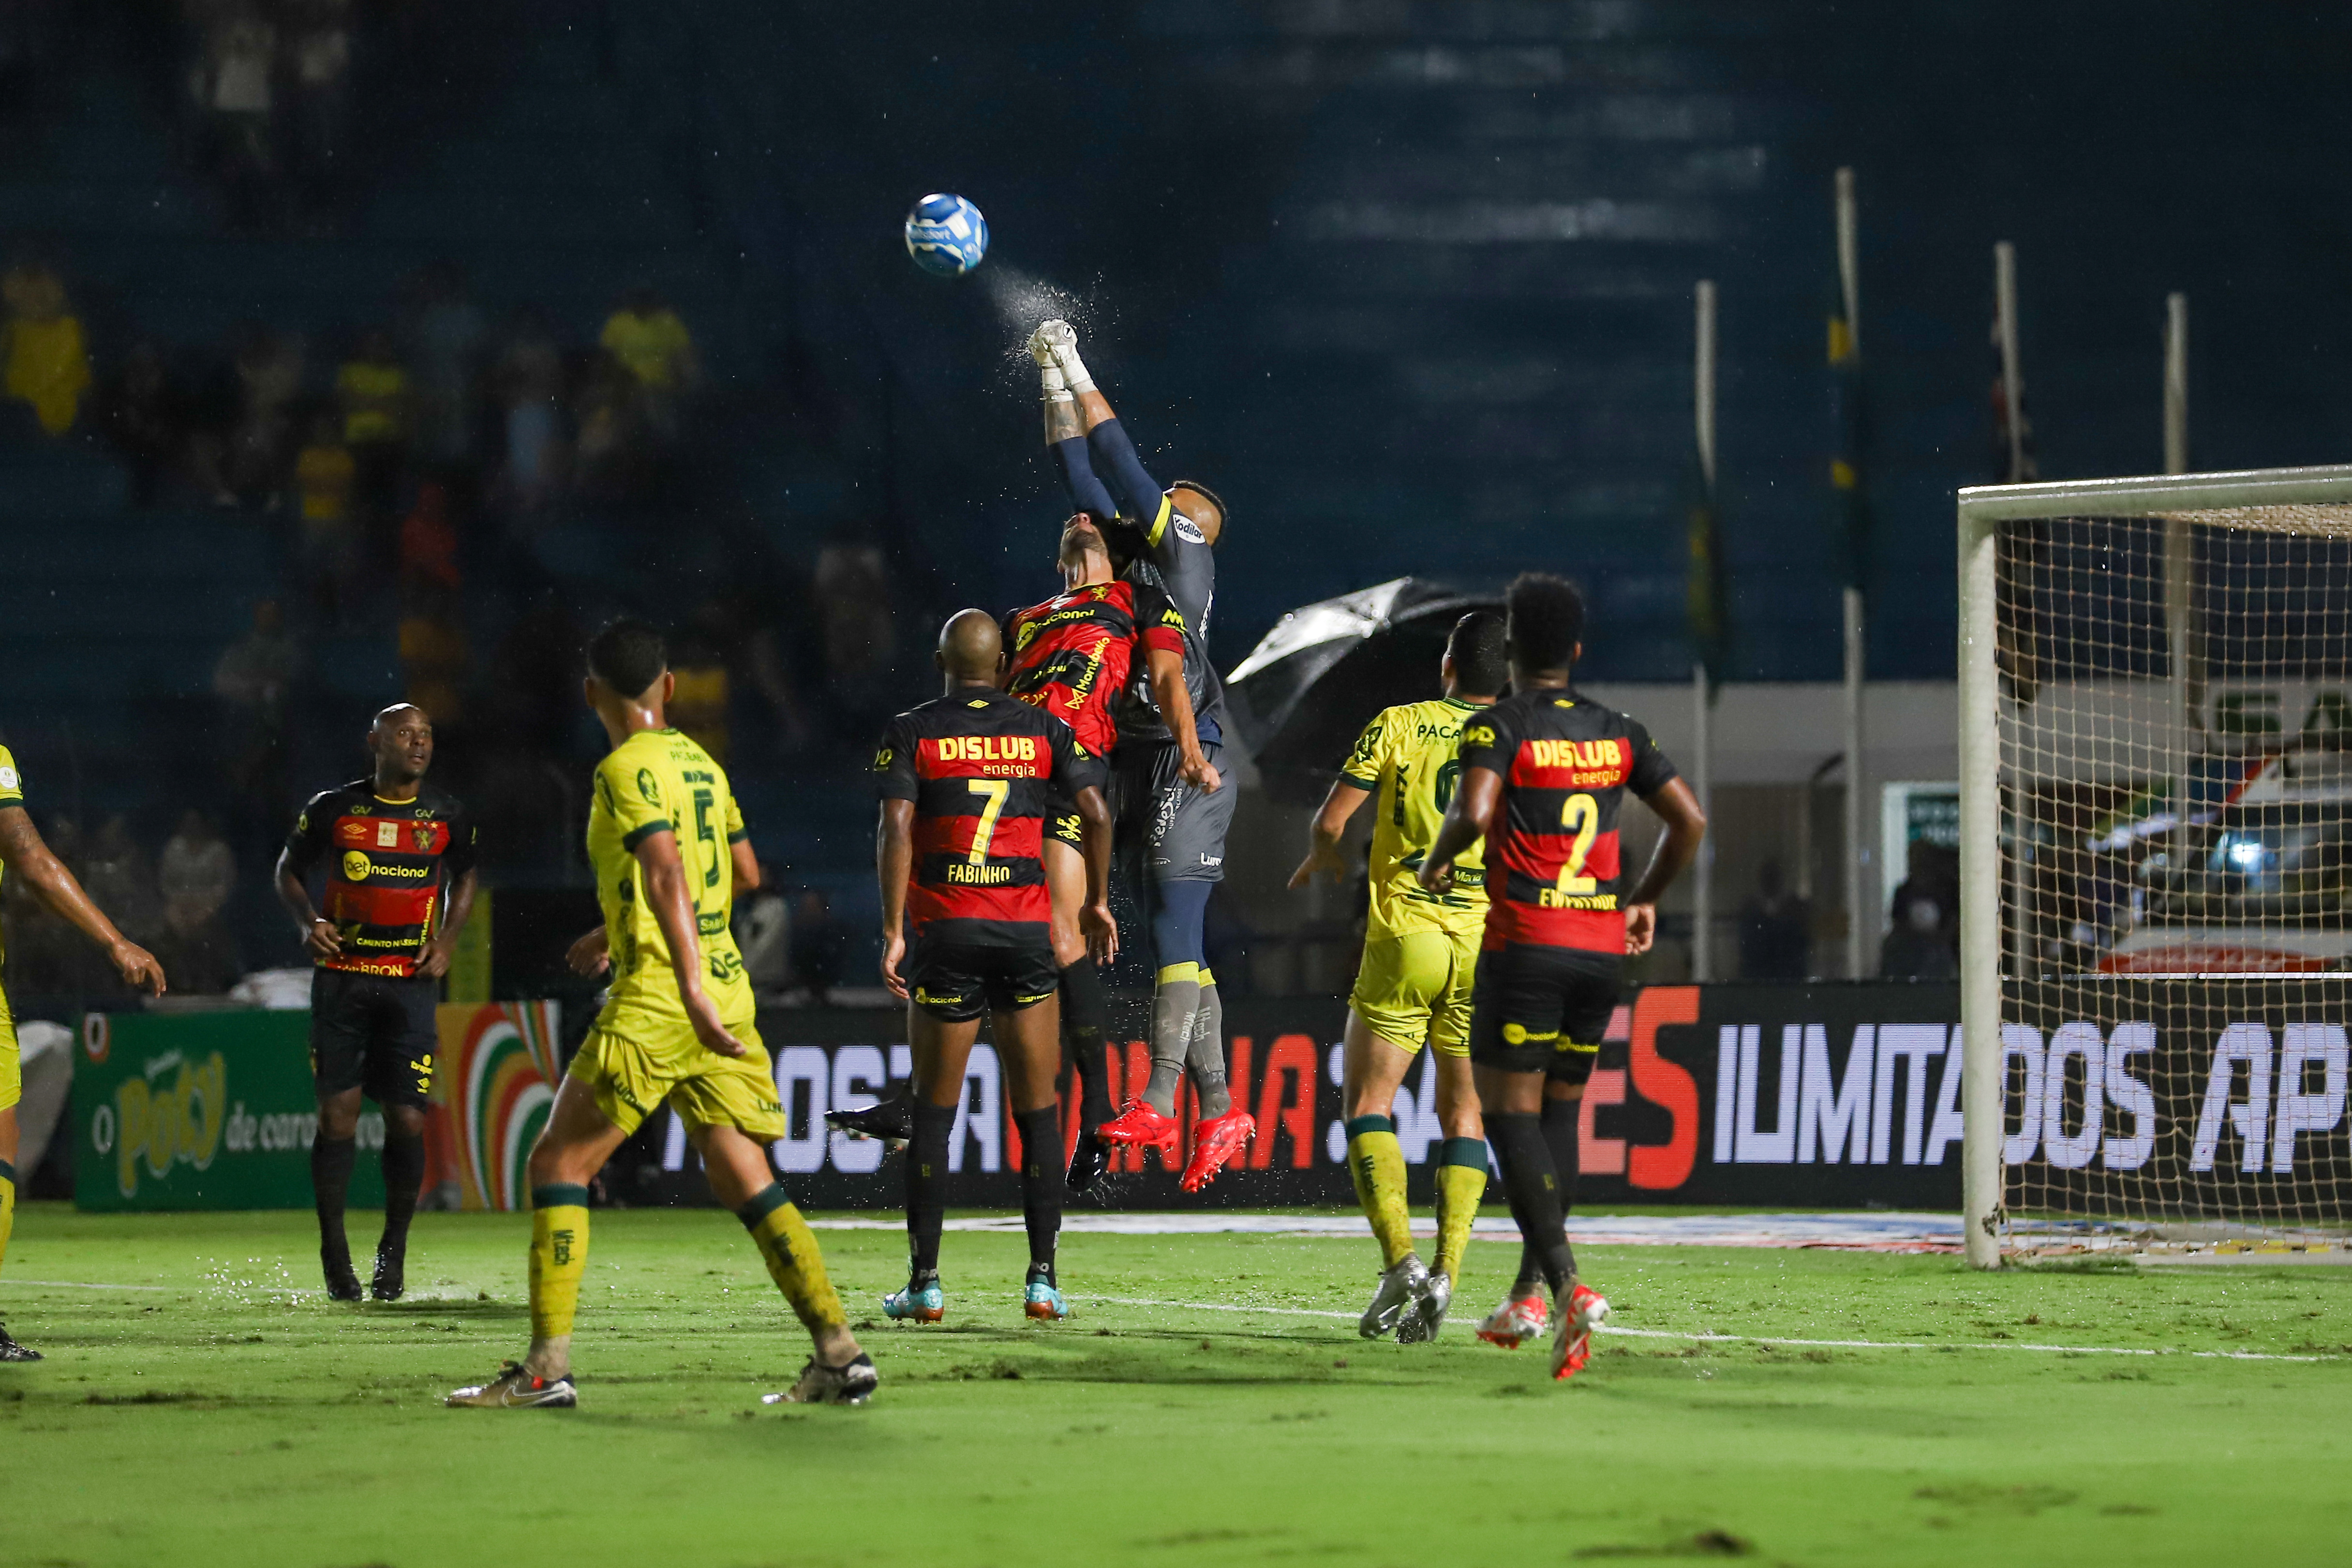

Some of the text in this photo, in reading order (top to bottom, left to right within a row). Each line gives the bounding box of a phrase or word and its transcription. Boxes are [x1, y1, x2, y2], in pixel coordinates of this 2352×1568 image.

[1075, 637, 1111, 691] Montbello
[1418, 725, 1460, 739] PACA
[938, 736, 1036, 761] DISLUB
[1532, 739, 1622, 768] DISLUB
[983, 763, 1036, 778] energia
[1572, 768, 1621, 785] energia
[682, 770, 720, 888] 5
[968, 779, 1011, 866] 7
[1556, 792, 1598, 895] 2
[371, 866, 430, 879] nacional
[948, 864, 1011, 884] FABINHO
[226, 1100, 258, 1151] de
